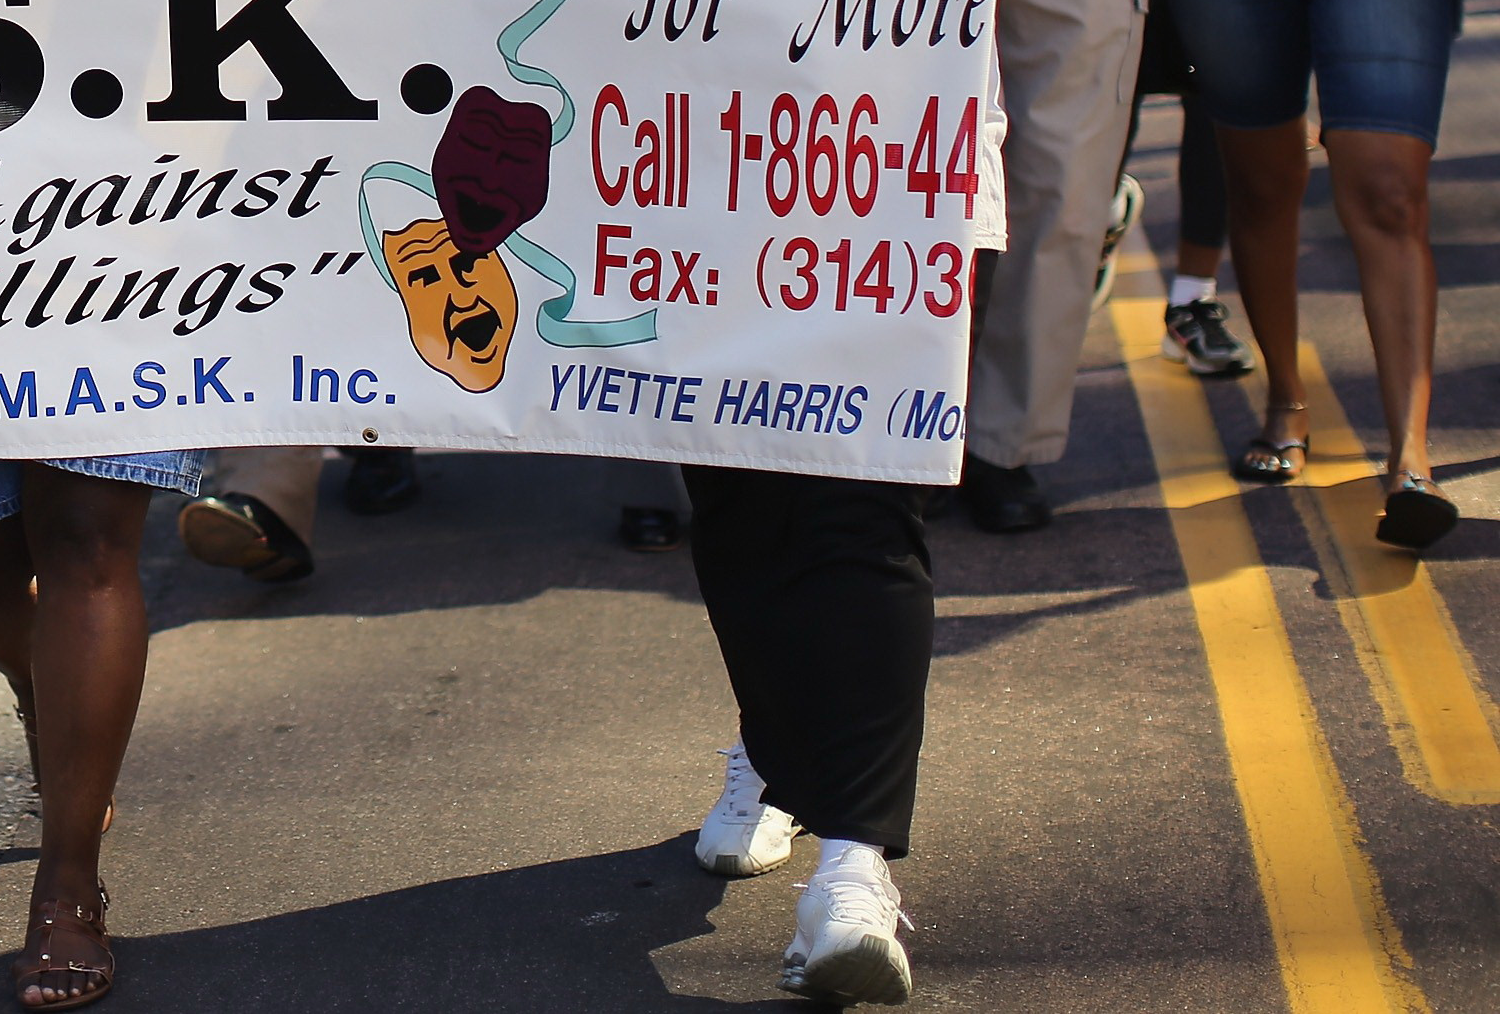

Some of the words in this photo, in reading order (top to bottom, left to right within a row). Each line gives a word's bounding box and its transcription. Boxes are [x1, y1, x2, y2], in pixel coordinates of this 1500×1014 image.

[591, 83, 690, 208] Call
[593, 223, 719, 306] Fax:
[756, 237, 975, 318] (314)3
[292, 355, 396, 405] Inc.
[550, 364, 703, 423] YVETTE
[714, 379, 868, 435] HARRIS
